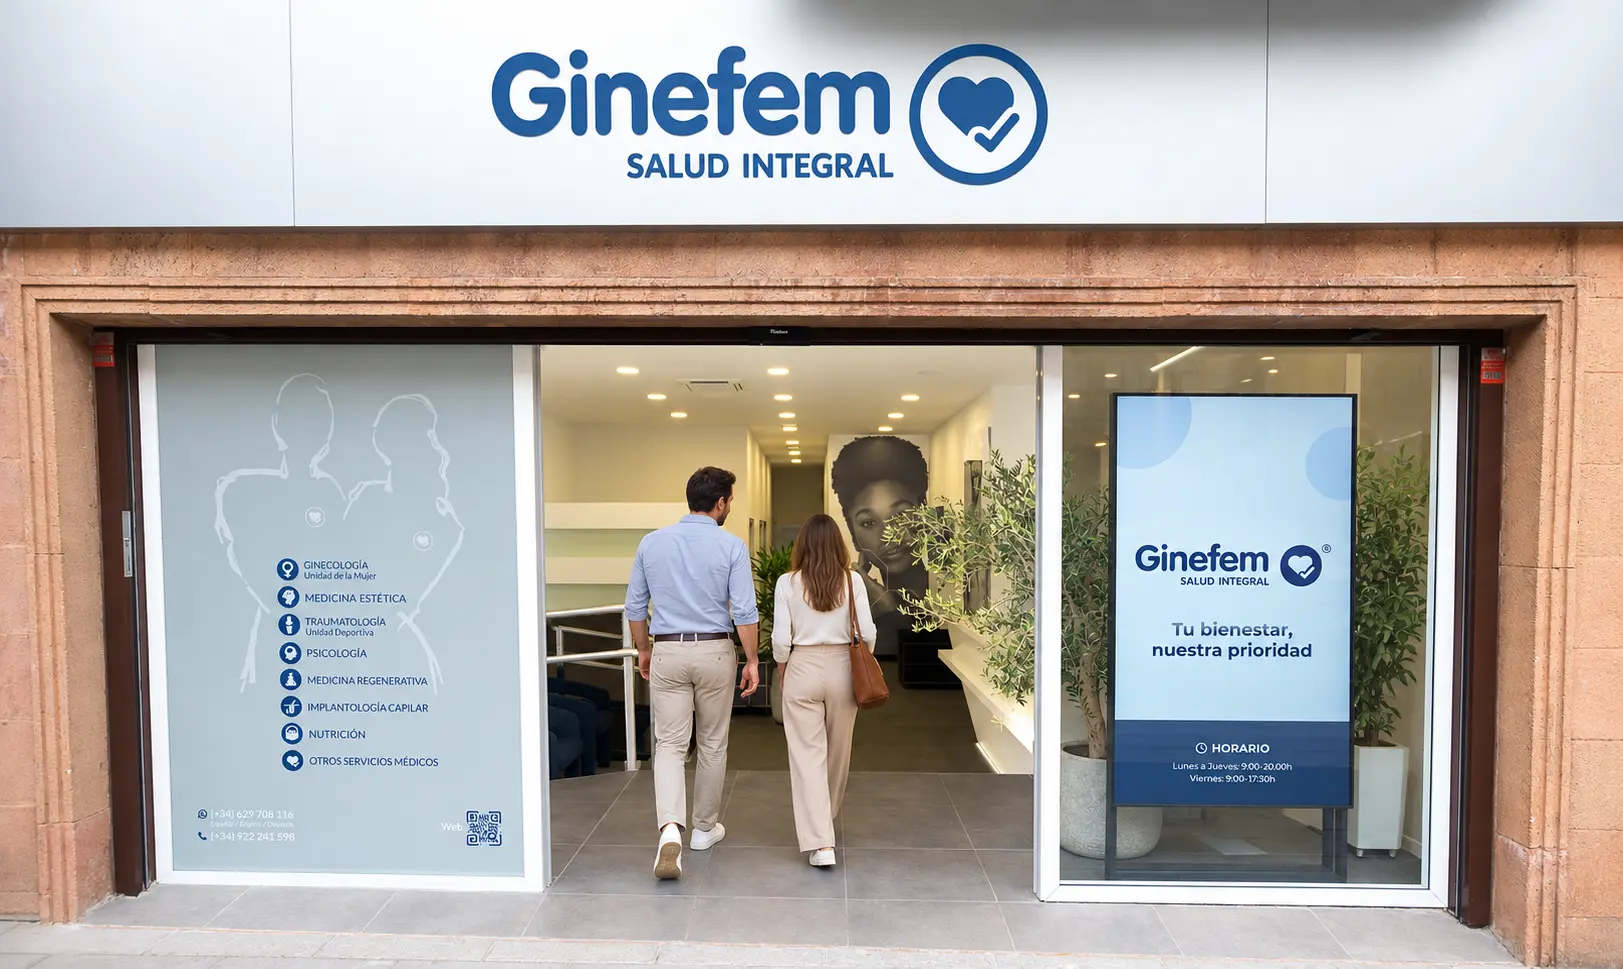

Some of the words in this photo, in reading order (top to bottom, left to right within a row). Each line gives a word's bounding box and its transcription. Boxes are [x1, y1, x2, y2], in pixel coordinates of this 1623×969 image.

[491, 45, 891, 138] Ginefem
[626, 152, 730, 179] SALUD
[742, 152, 894, 179] INTEGRAL
[1135, 543, 1269, 572] Ginefem
[303, 560, 369, 570] GINECOLOGÍA
[304, 571, 332, 580] Unidad
[334, 571, 344, 580] de
[345, 571, 352, 580] la
[354, 572, 377, 581] Mujer
[1180, 576, 1215, 586] SALUD
[1218, 576, 1270, 586] INTEGRAL
[305, 593, 357, 603] MEDICINA
[359, 592, 407, 604] ESTÉTICA
[305, 616, 386, 627] TRAUMATOLOGÍA
[335, 628, 374, 638] Deportiva
[1172, 622, 1194, 637] Tu
[1201, 621, 1293, 639] bienestar,
[306, 648, 367, 658] PSICOLOGÍA
[1152, 644, 1222, 657] nuestra
[1228, 642, 1312, 660] prioridad
[307, 676, 356, 685] MEDICINA
[357, 676, 428, 686] REGENERATIVA
[307, 702, 387, 712] IMPLANTOLOGÍA
[388, 704, 429, 713] CAPILAR
[308, 729, 366, 739] NUTRICIÓN
[1212, 743, 1270, 754] HORARIO
[309, 757, 342, 766] OTROS
[343, 757, 393, 766] SERVICIOS
[394, 756, 439, 767] MÉDICOS
[1172, 762, 1199, 770] Lunes
[210, 809, 235, 820] (+34)
[236, 809, 255, 819] 629
[256, 809, 275, 819] 708
[276, 809, 295, 819] 116
[440, 822, 463, 832] Web
[210, 832, 235, 842] (+34)
[236, 832, 255, 841] 922
[256, 832, 275, 841] 241
[276, 832, 296, 841] 598
